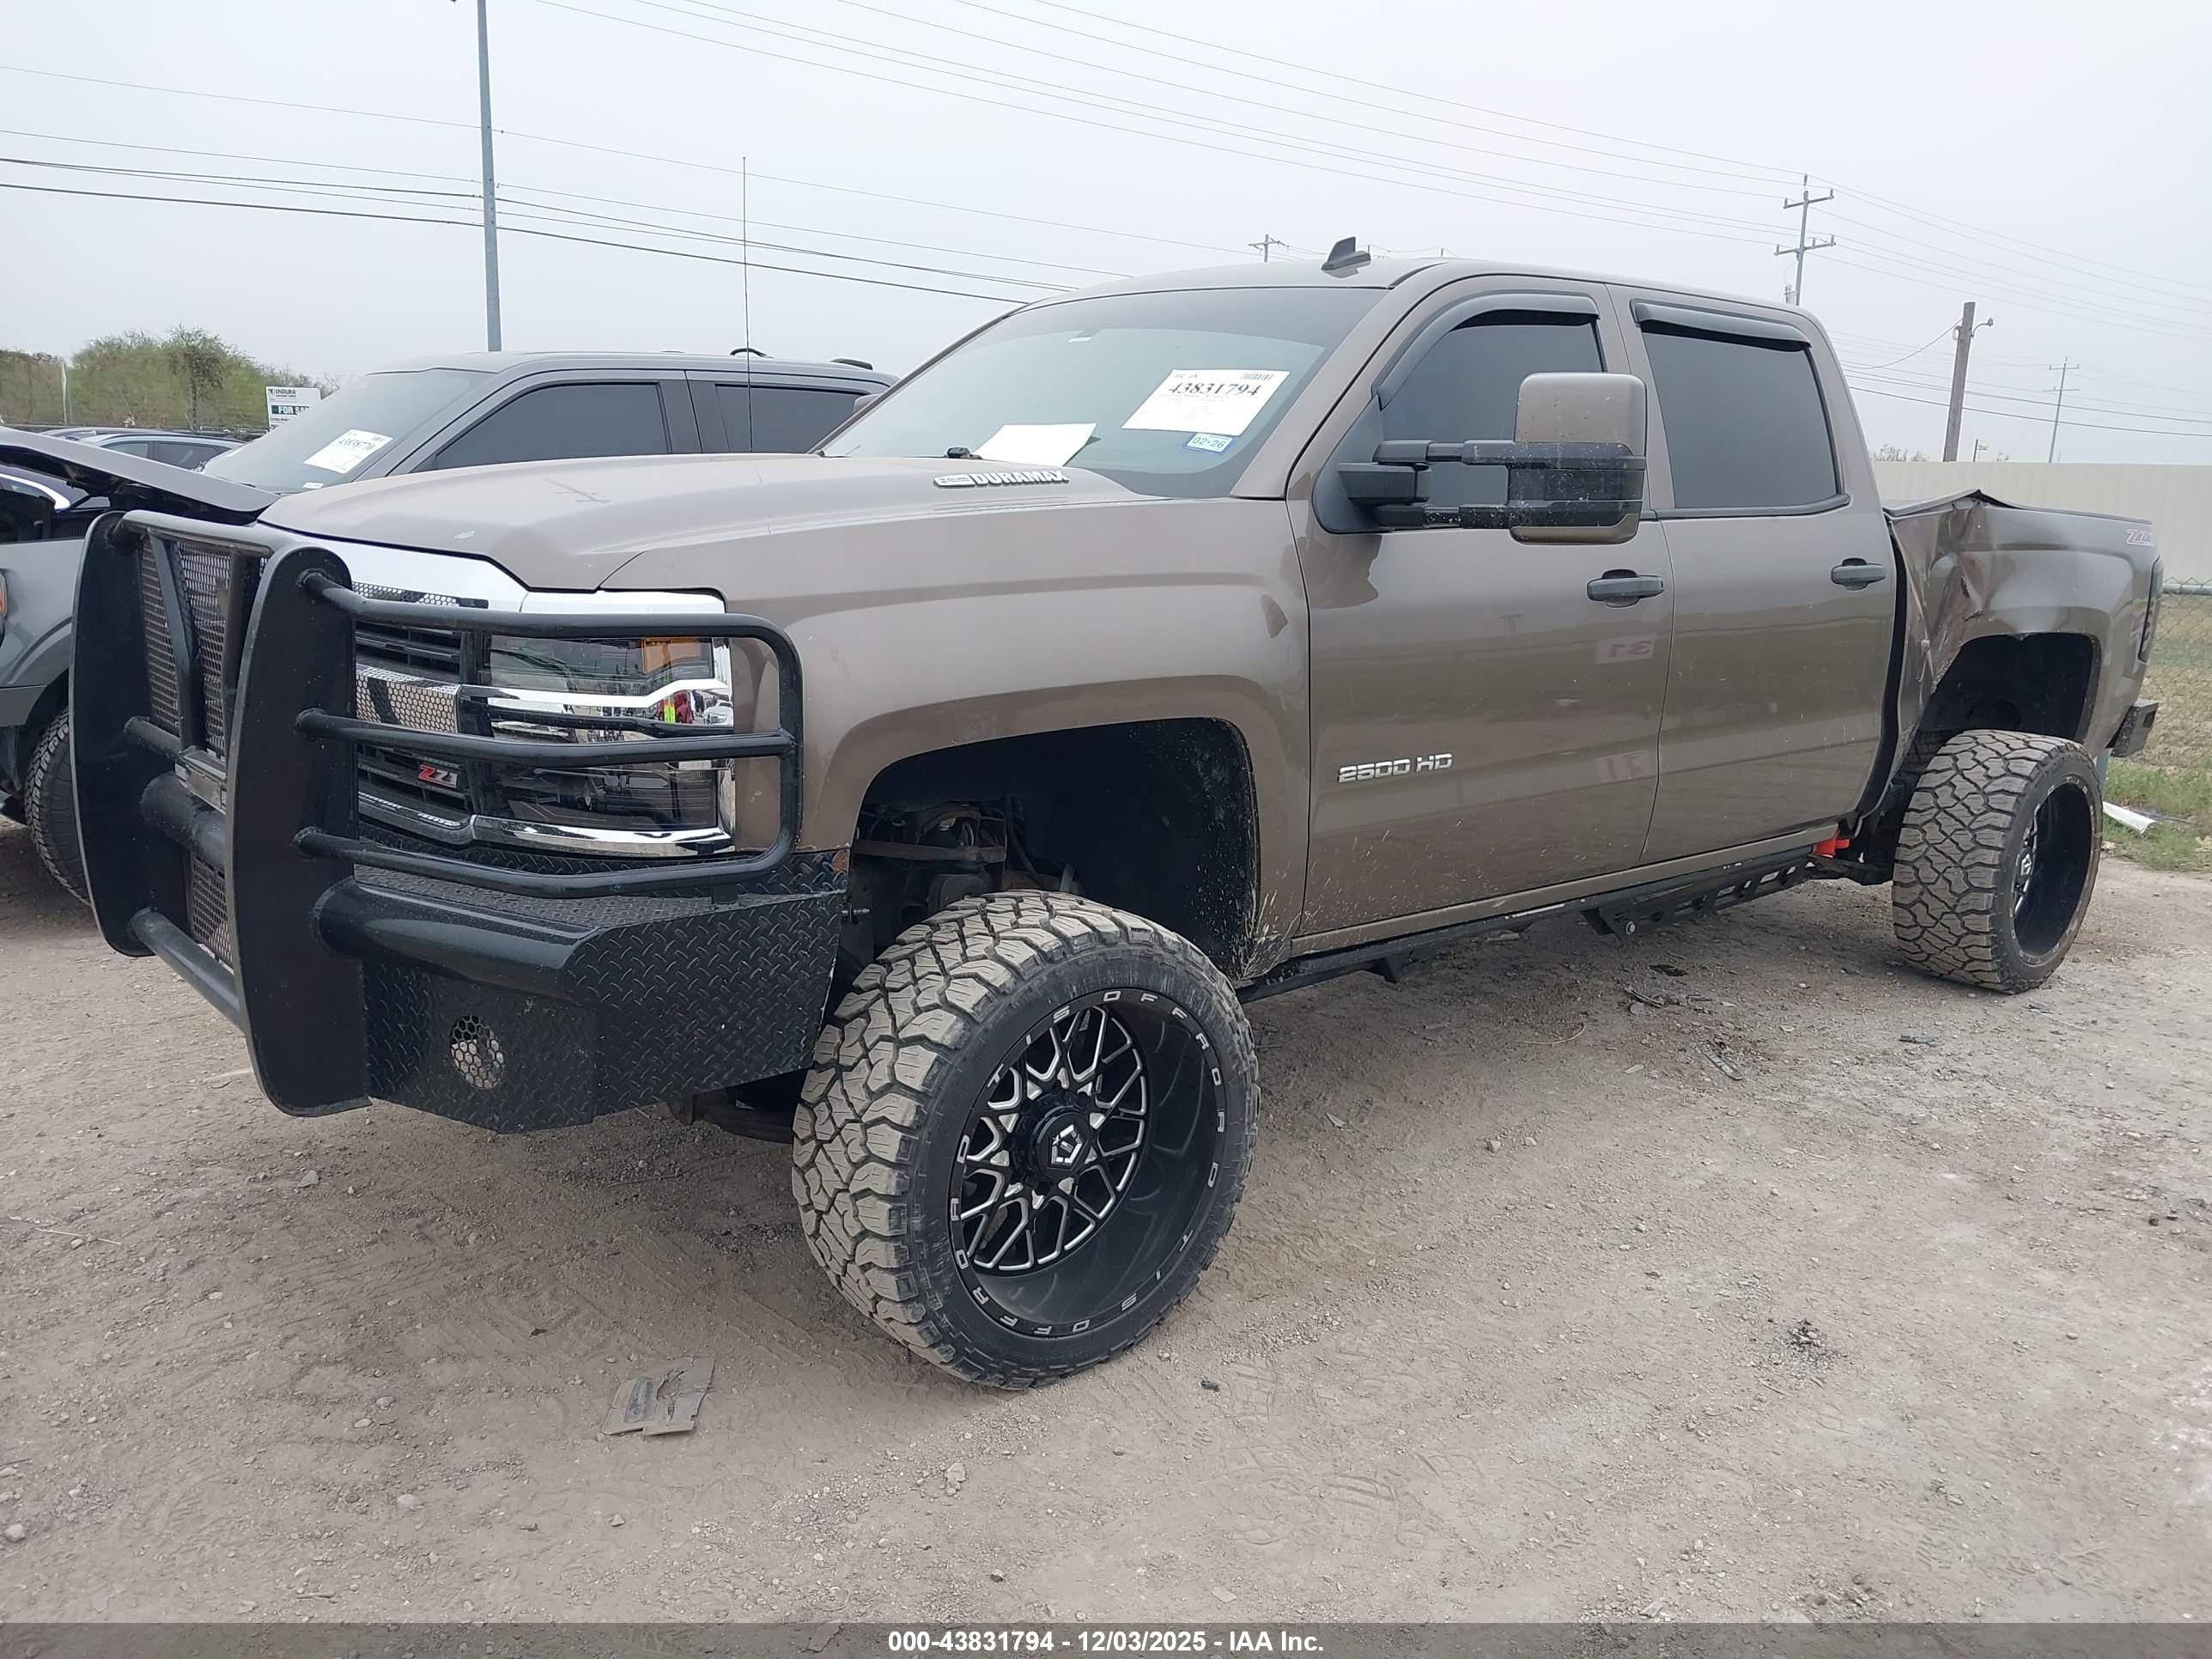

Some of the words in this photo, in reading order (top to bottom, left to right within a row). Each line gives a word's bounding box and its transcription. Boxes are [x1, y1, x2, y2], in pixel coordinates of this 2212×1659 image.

[1169, 381, 1262, 396] 43831794
[278, 405, 294, 414] FOR
[969, 470, 1070, 486] DURAMAX
[418, 763, 458, 788] Z71
[1338, 758, 1411, 783] 2500
[1416, 753, 1453, 773] HD
[987, 1006, 1072, 1089] TIS
